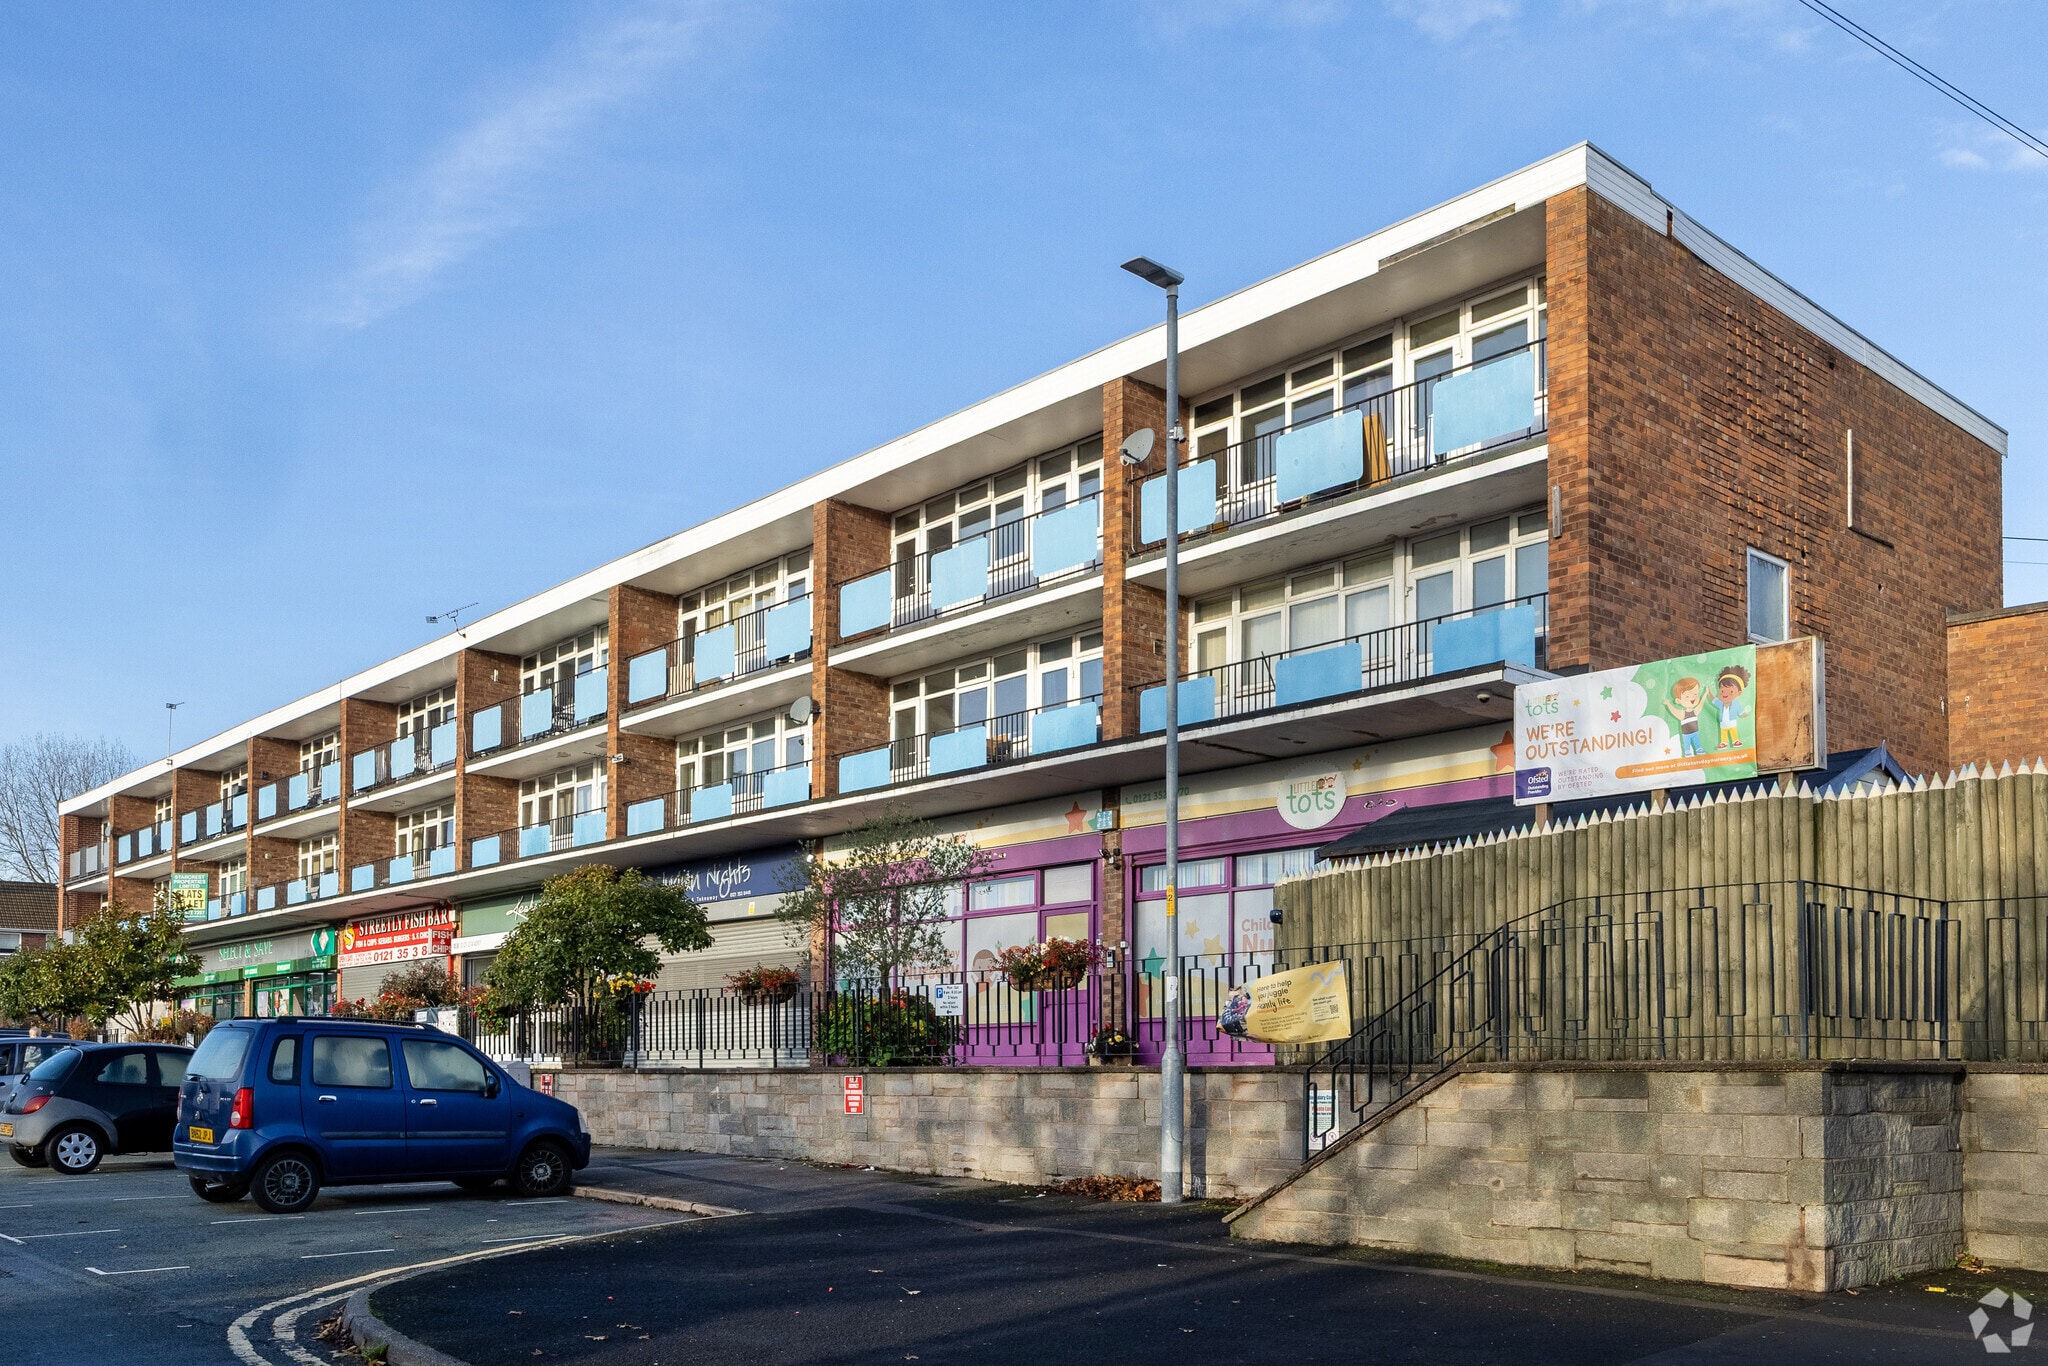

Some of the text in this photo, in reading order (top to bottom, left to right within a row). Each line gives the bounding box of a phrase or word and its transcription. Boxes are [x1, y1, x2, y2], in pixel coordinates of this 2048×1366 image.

[1525, 699, 1559, 717] tots
[1526, 721, 1575, 742] WE'RE
[1525, 727, 1653, 761] OUTSTANDING!
[1558, 766, 1599, 777] WE'RE RATED
[1558, 772, 1604, 784] OUTSTANDING
[1293, 779, 1317, 794] LITTLE
[1528, 774, 1549, 785] Ofsted
[1568, 781, 1593, 789] OFSTED
[1133, 793, 1151, 804] 0121
[1286, 783, 1336, 815] tots
[706, 857, 751, 899] Nights
[359, 908, 448, 937] STREETLY FISH BAR
[432, 930, 454, 939] FISH
[218, 944, 242, 962] SELECT
[244, 944, 251, 959] &
[254, 940, 273, 957] SAVE
[373, 950, 393, 962] 0121
[1257, 979, 1292, 993] Here to help
[1258, 988, 1289, 1002] you juggle
[1278, 997, 1292, 1006] life
